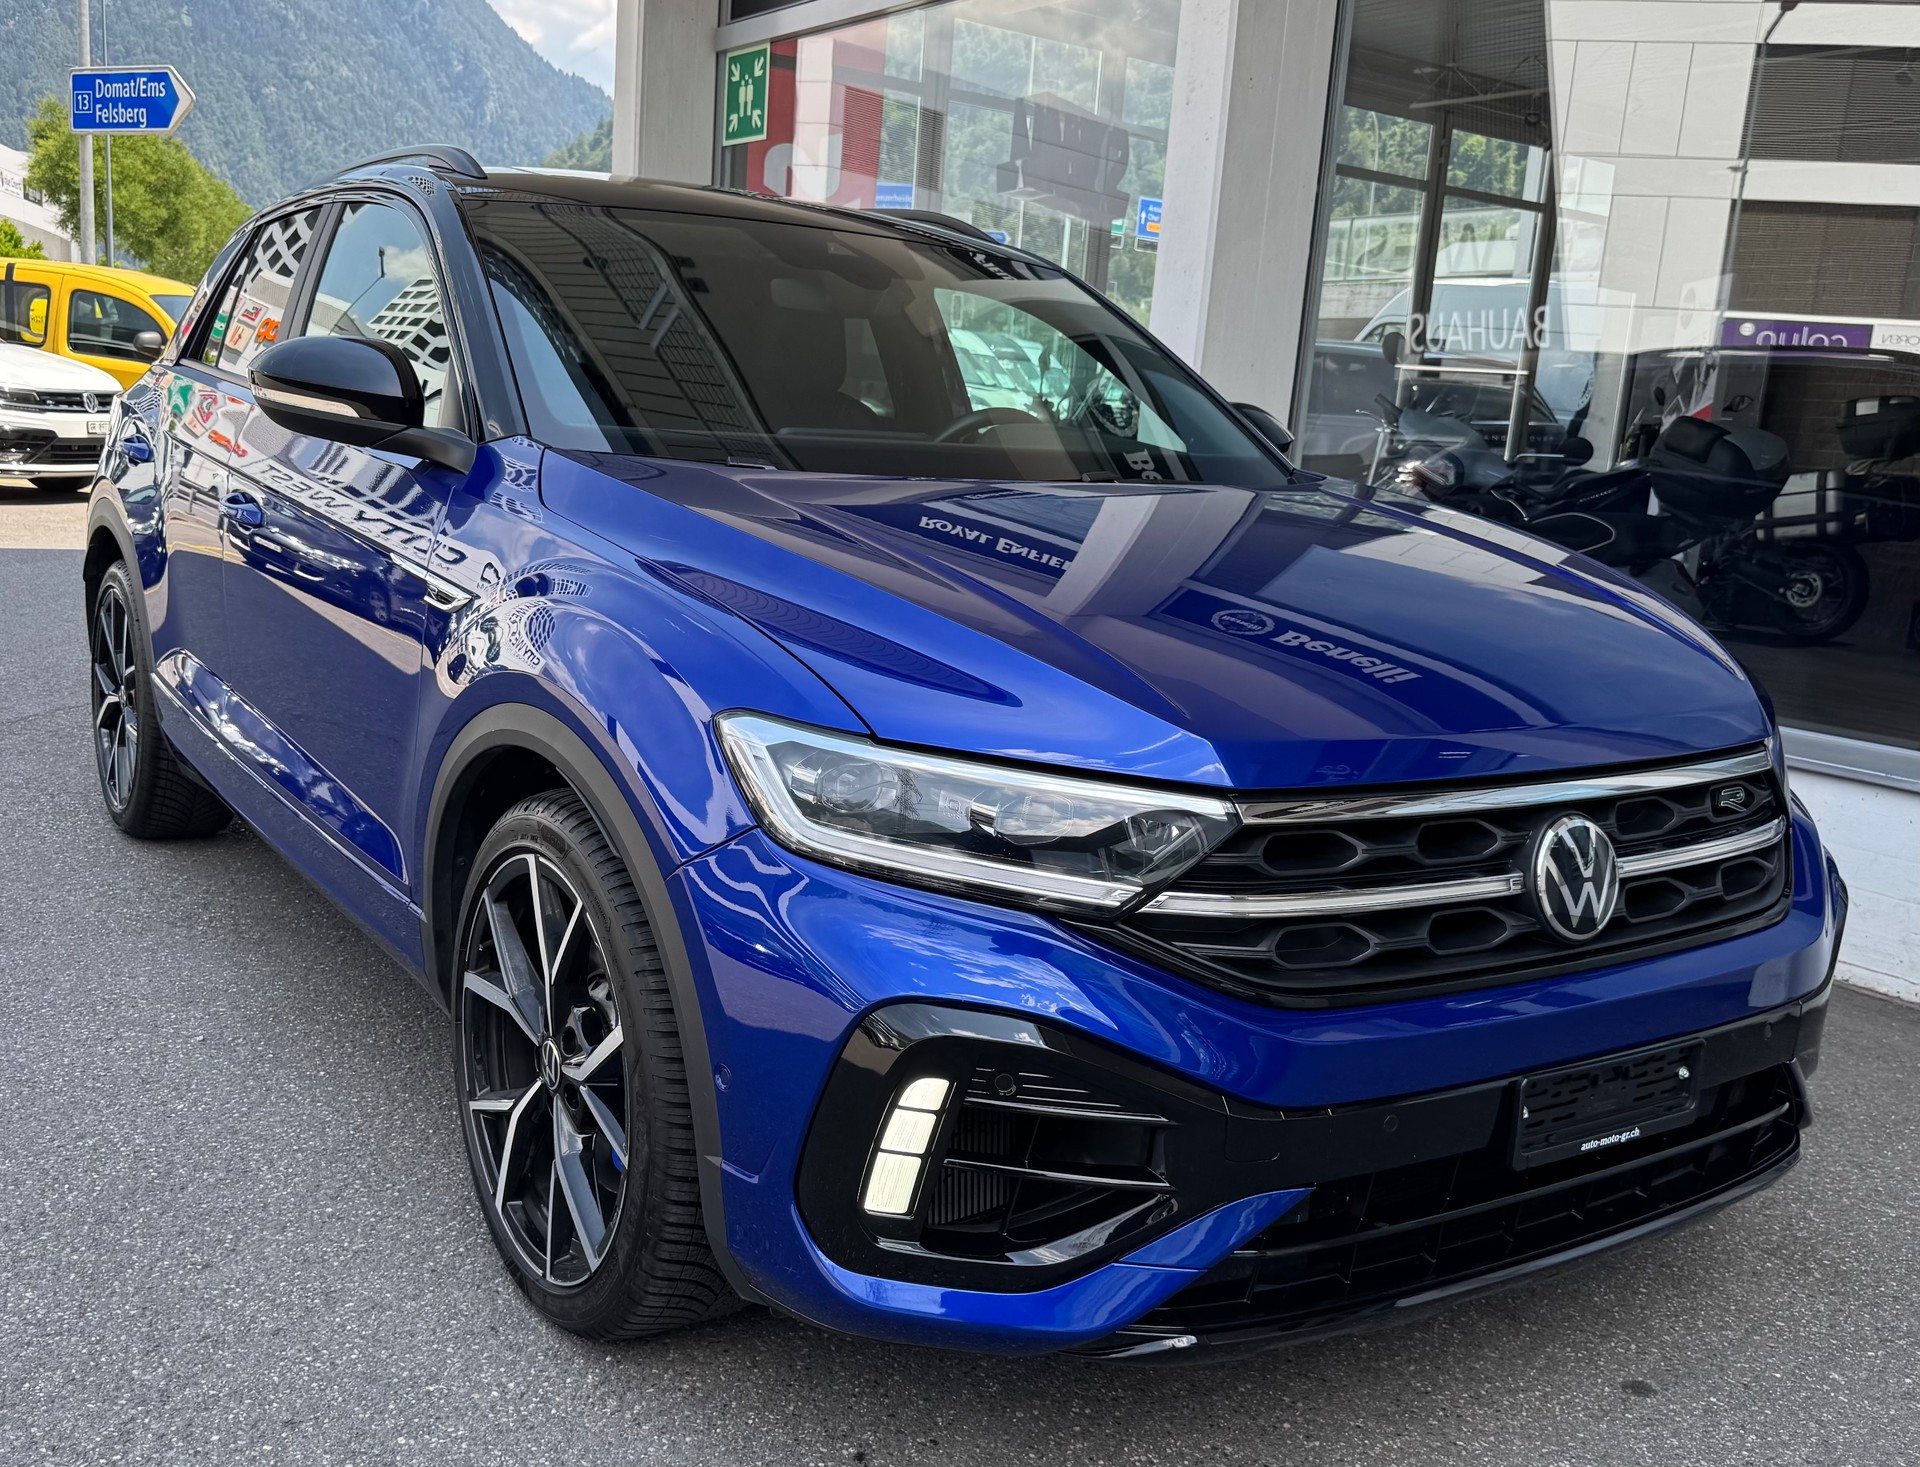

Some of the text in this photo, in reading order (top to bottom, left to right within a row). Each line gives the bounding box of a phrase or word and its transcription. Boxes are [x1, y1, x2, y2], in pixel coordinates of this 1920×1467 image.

[96, 77, 166, 98] Domat/Ems
[77, 94, 89, 110] 13
[96, 102, 147, 128] Felsberg
[1580, 1126, 1641, 1151] auto-moto-gr.ch
